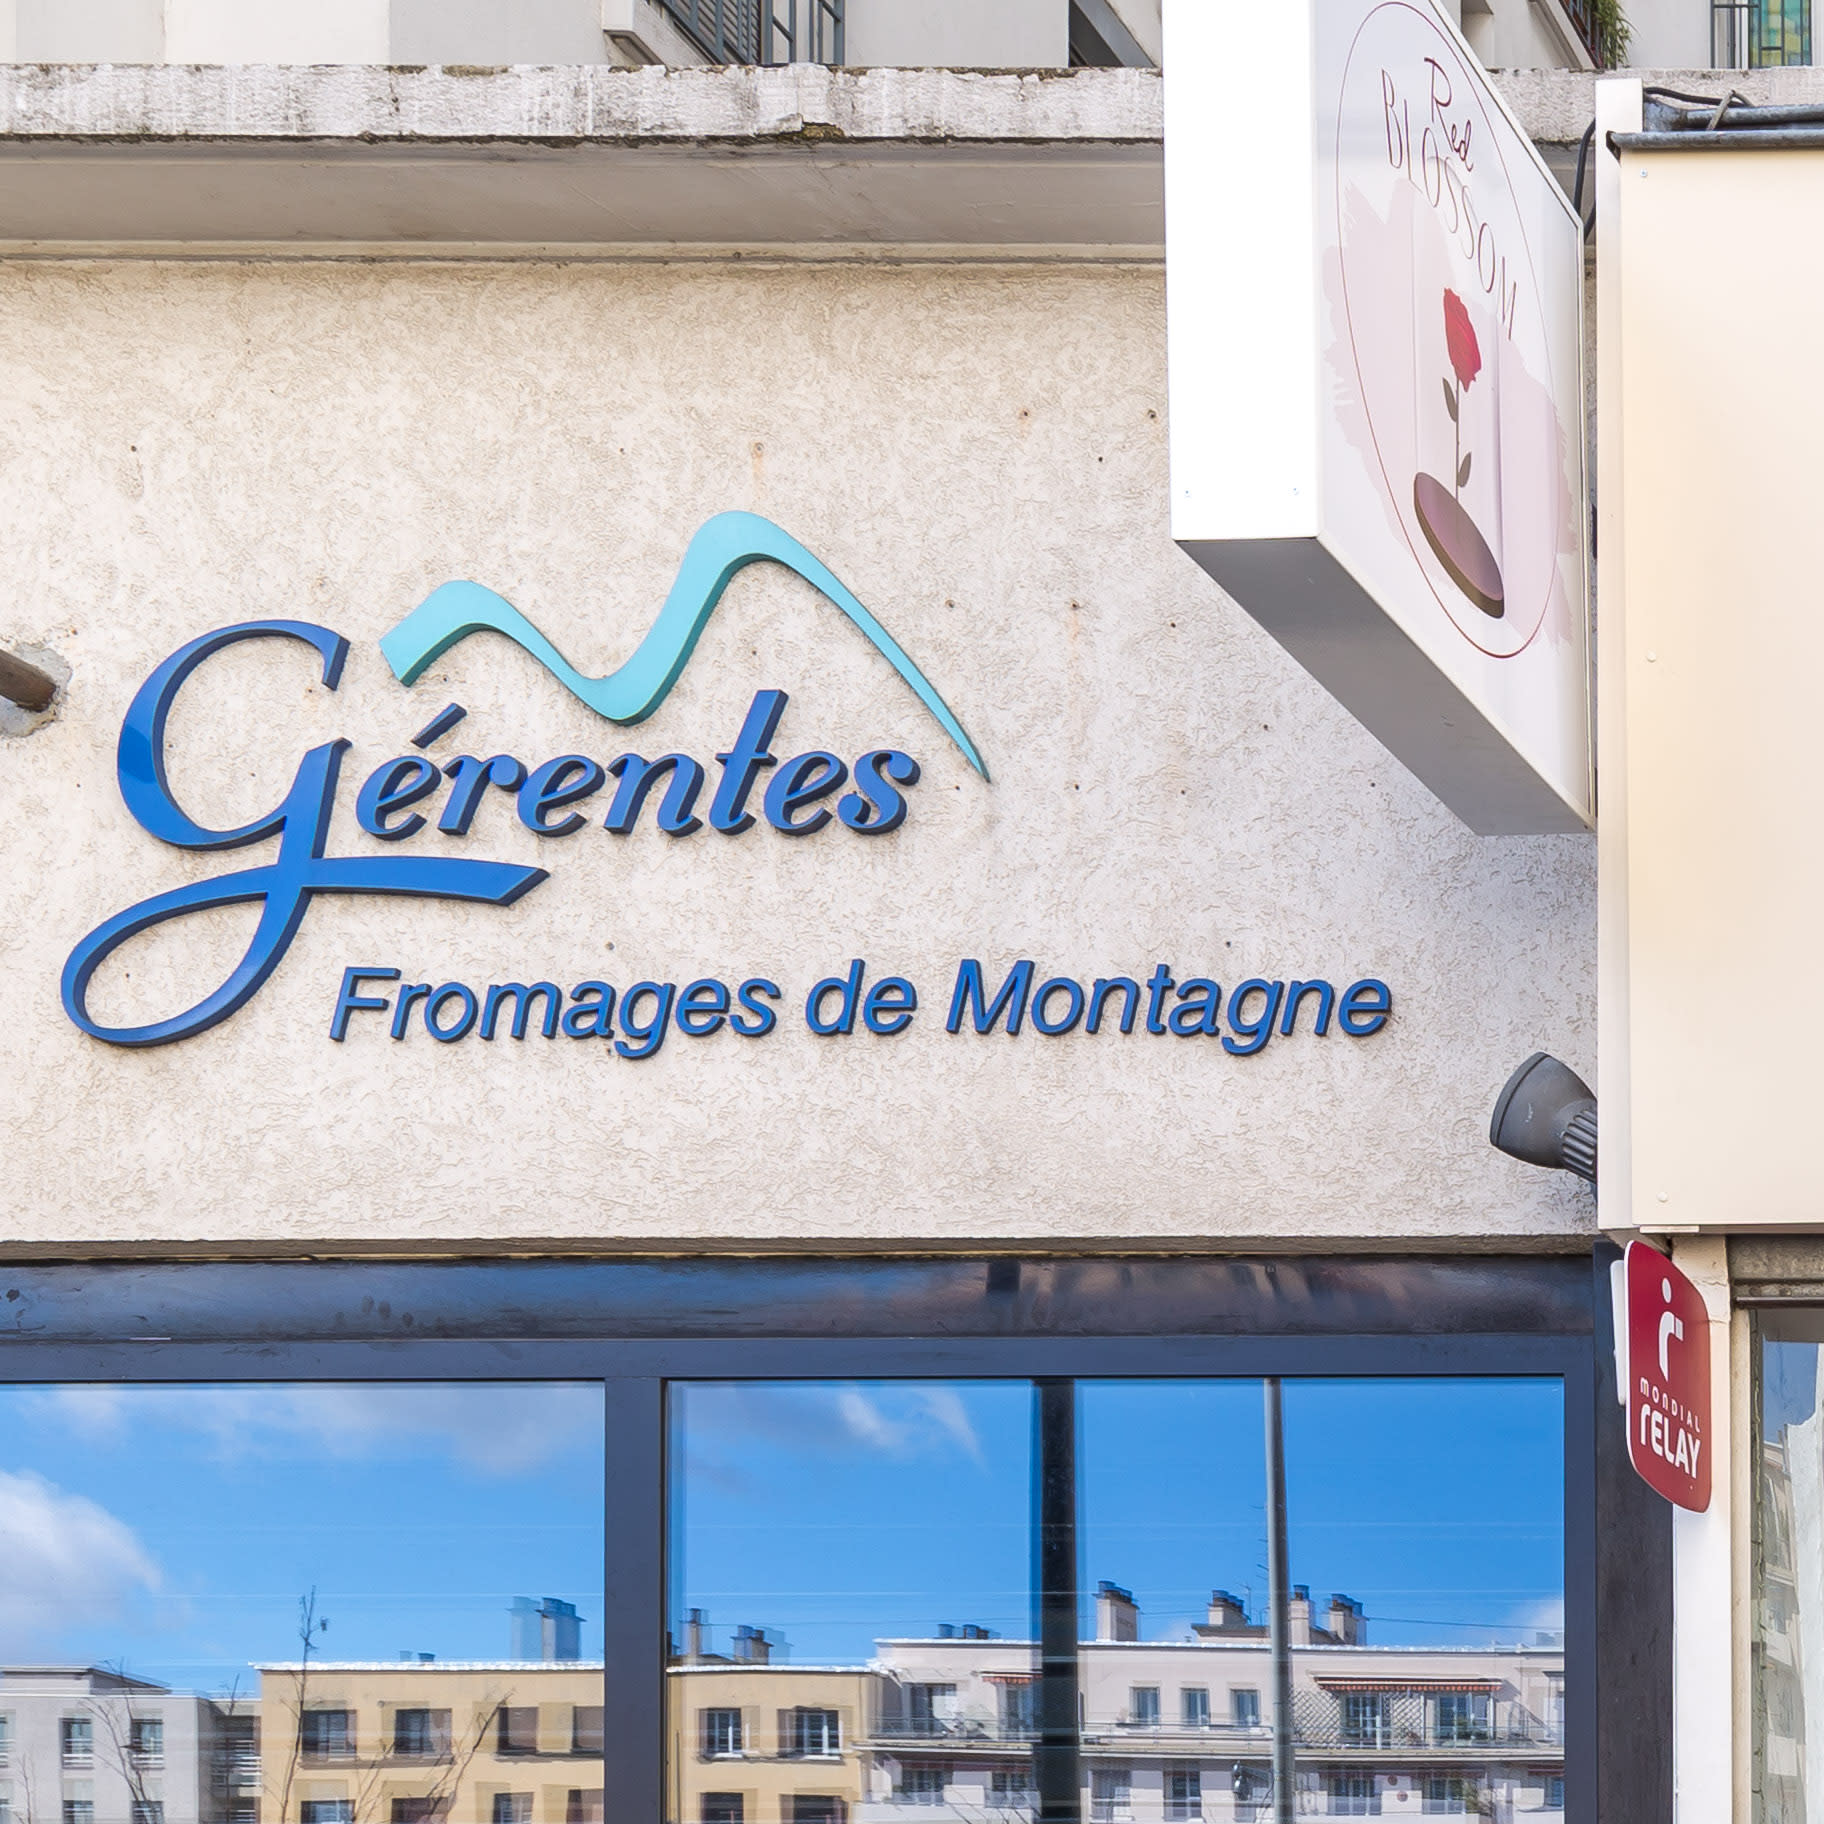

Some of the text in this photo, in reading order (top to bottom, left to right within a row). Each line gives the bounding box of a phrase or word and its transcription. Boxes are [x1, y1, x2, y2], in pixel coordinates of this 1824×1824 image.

[1381, 69, 1517, 340] BLOSSOM
[1424, 57, 1474, 172] Red
[60, 618, 922, 1048] Gérentes
[327, 957, 1396, 1060] Fromages de Montagne
